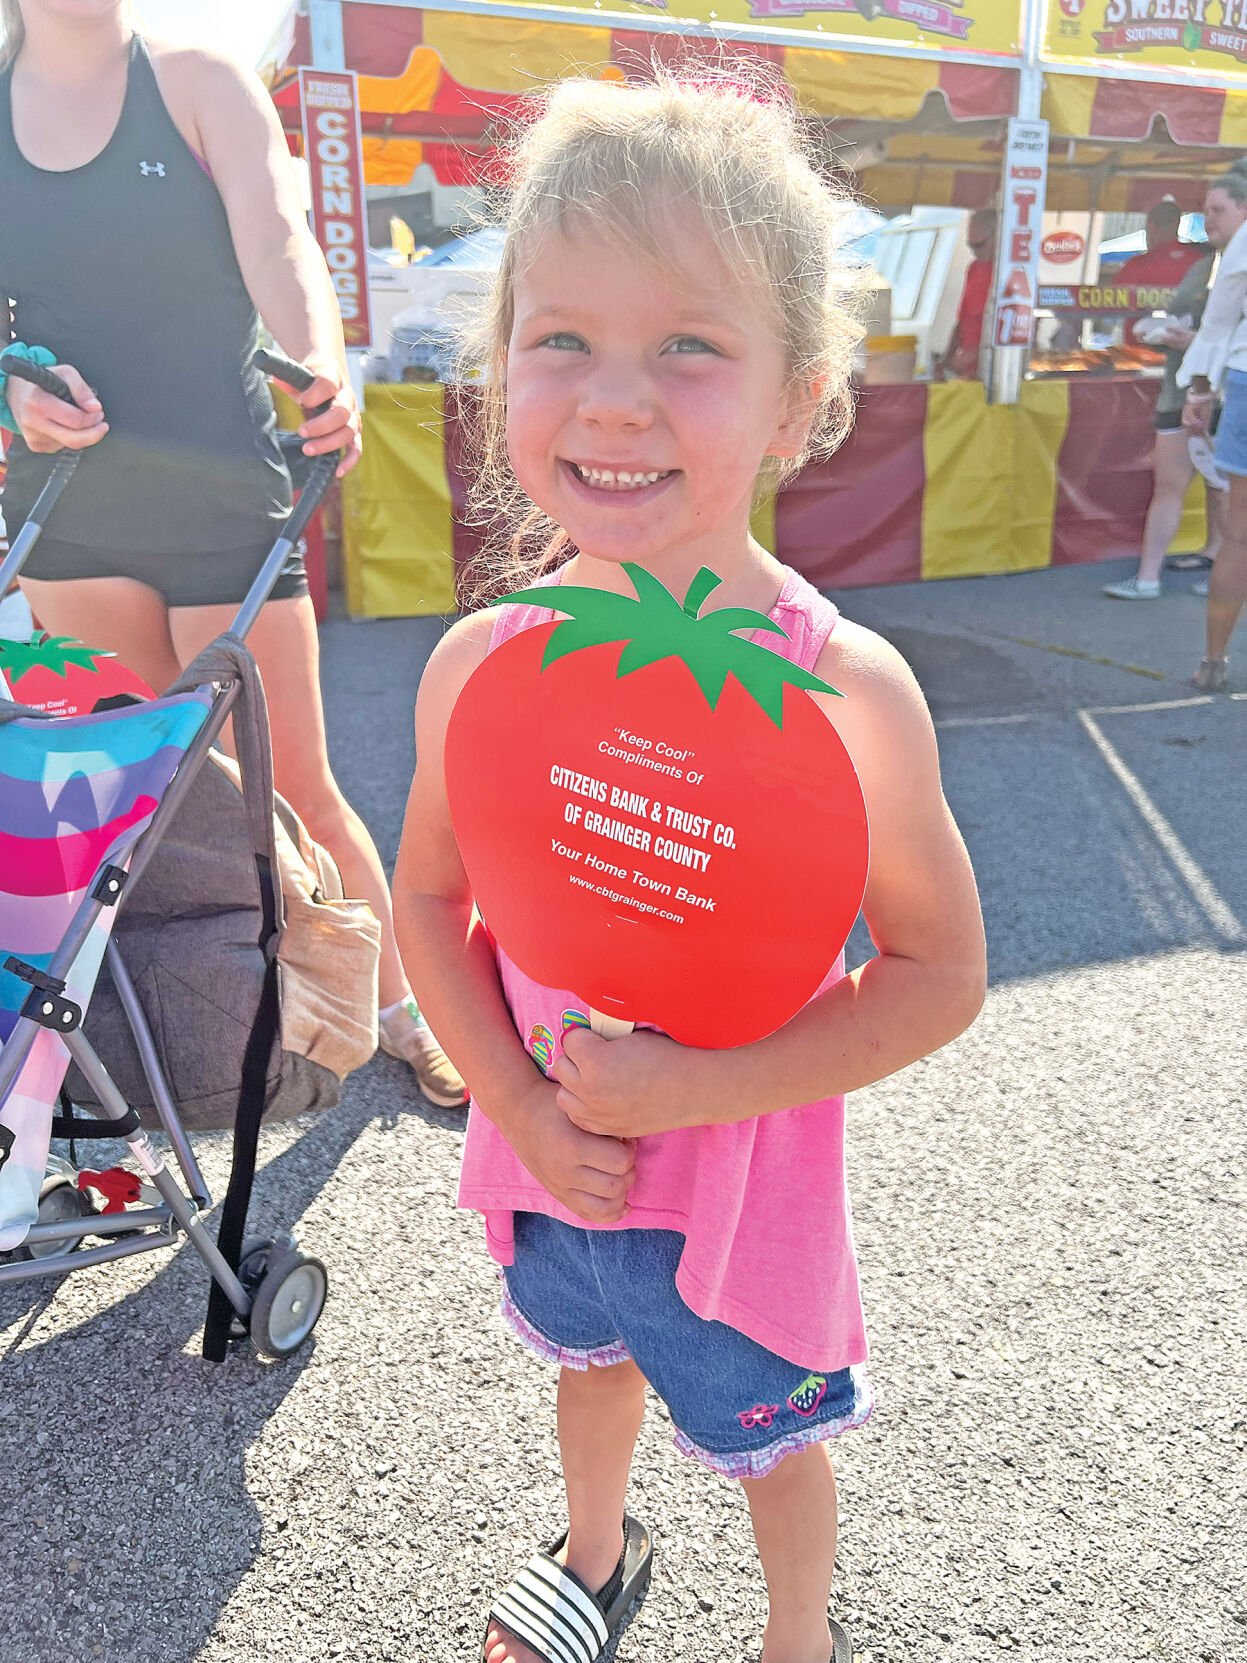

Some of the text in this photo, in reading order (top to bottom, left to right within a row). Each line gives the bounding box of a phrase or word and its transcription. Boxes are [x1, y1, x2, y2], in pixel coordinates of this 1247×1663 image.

[1125, 27, 1179, 42] SOUTHERN
[316, 111, 359, 320] CORN DOGS
[1003, 188, 1037, 298] TEA
[1078, 287, 1129, 309] CORN
[598, 740, 704, 786] Compliments Of
[550, 764, 737, 850] CITIZENS BANK & TRUST CO.
[564, 802, 712, 873] OF GRAINGER COUNTY
[551, 838, 716, 912] Your Home Town Bank
[569, 874, 684, 924] www.cbtgrainger.com
